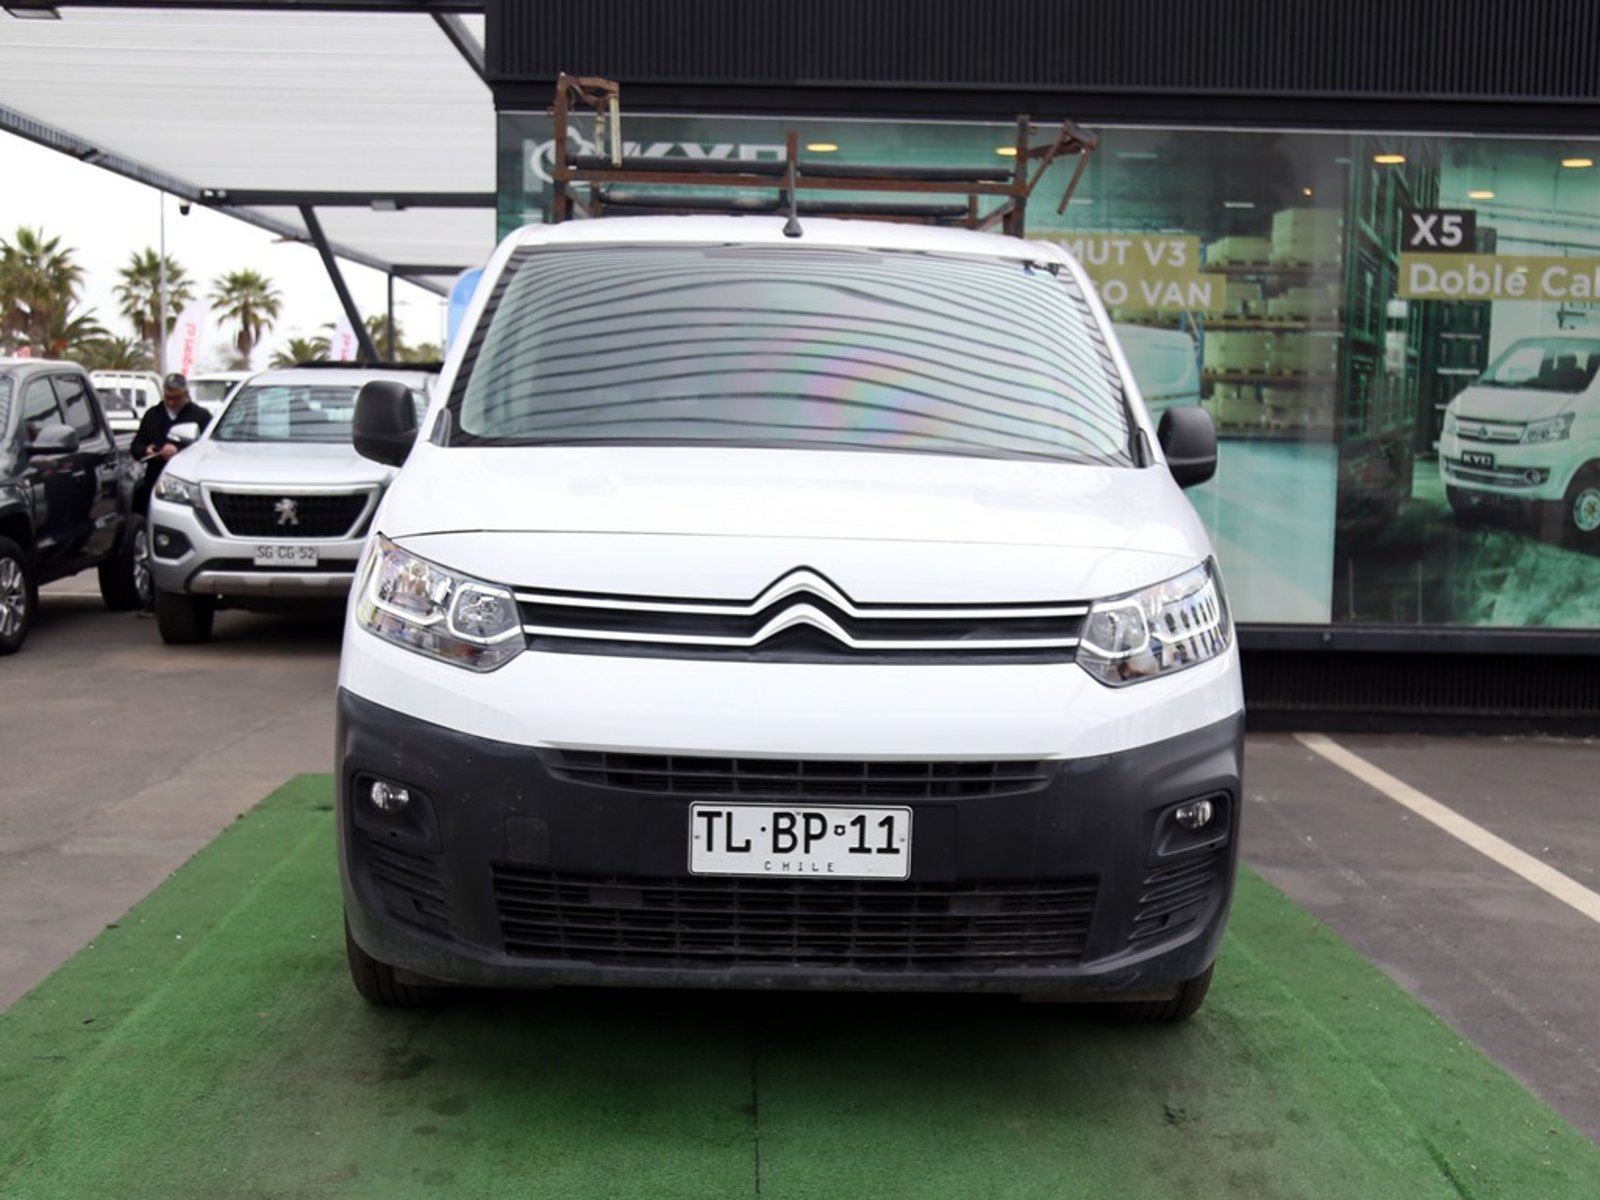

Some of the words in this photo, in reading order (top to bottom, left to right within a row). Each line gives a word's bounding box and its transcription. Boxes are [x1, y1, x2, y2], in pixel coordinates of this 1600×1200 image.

[1410, 214, 1463, 247] X5
[1059, 239, 1131, 266] MUT
[1142, 240, 1187, 267] V3
[1409, 263, 1527, 296] Doble
[1139, 280, 1212, 308] VAN
[764, 860, 835, 873] CHILE
